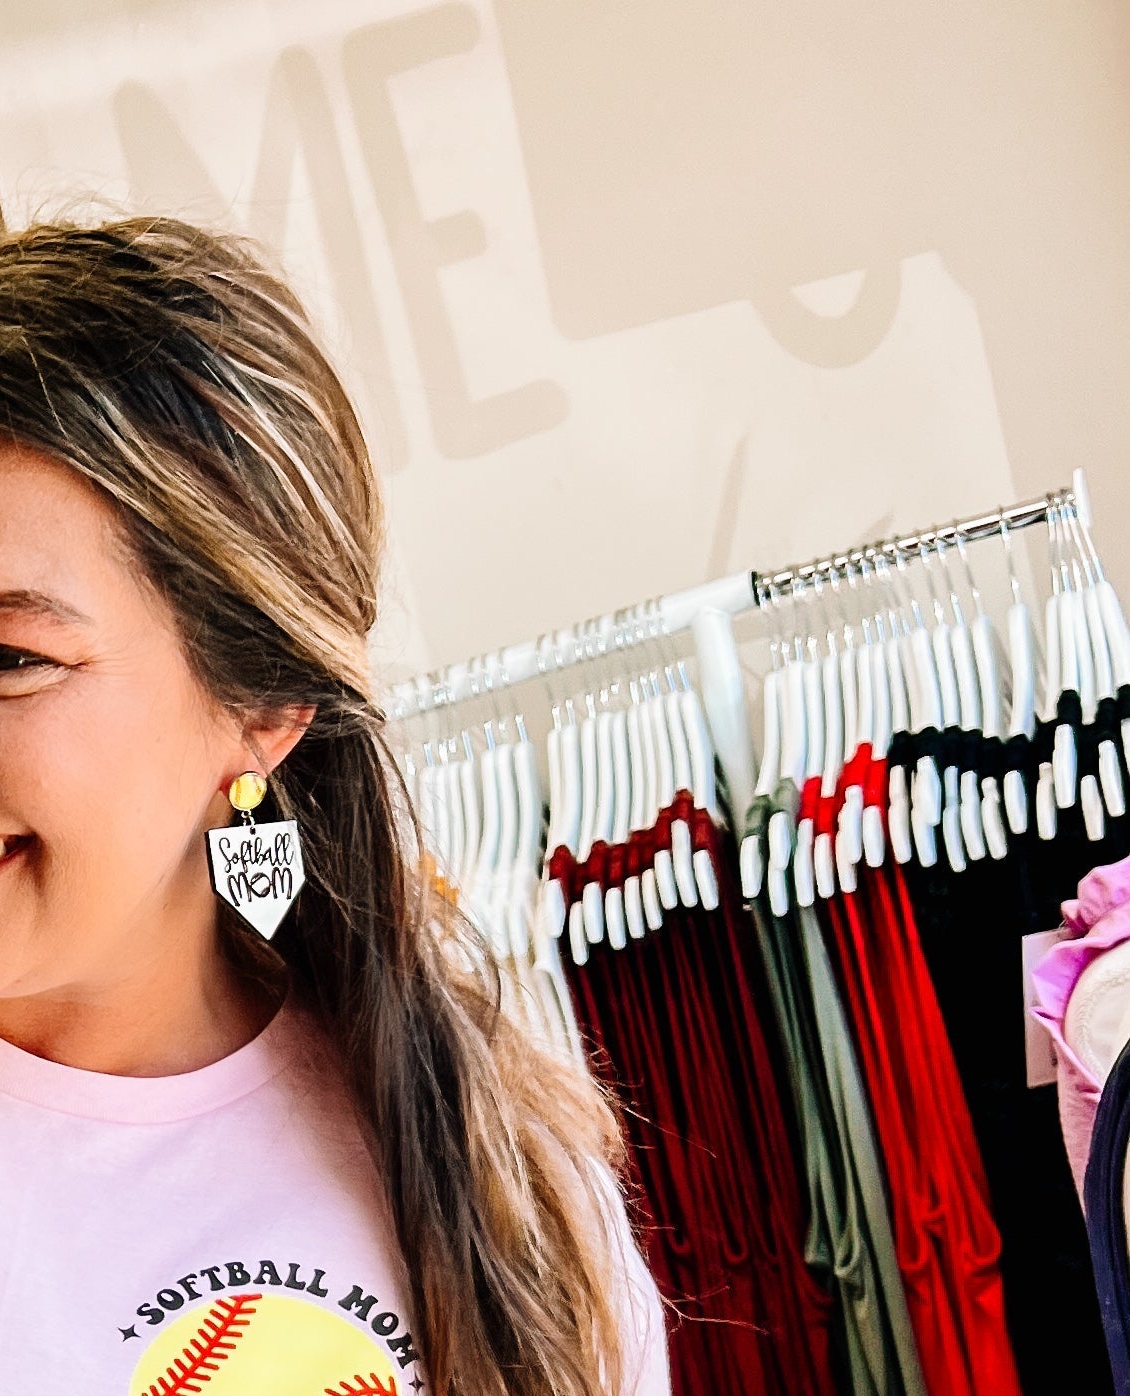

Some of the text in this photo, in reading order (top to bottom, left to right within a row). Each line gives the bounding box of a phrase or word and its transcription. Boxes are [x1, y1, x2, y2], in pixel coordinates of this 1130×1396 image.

[219, 833, 294, 873] Softball
[136, 1260, 420, 1369] SOFTBALL MOM
